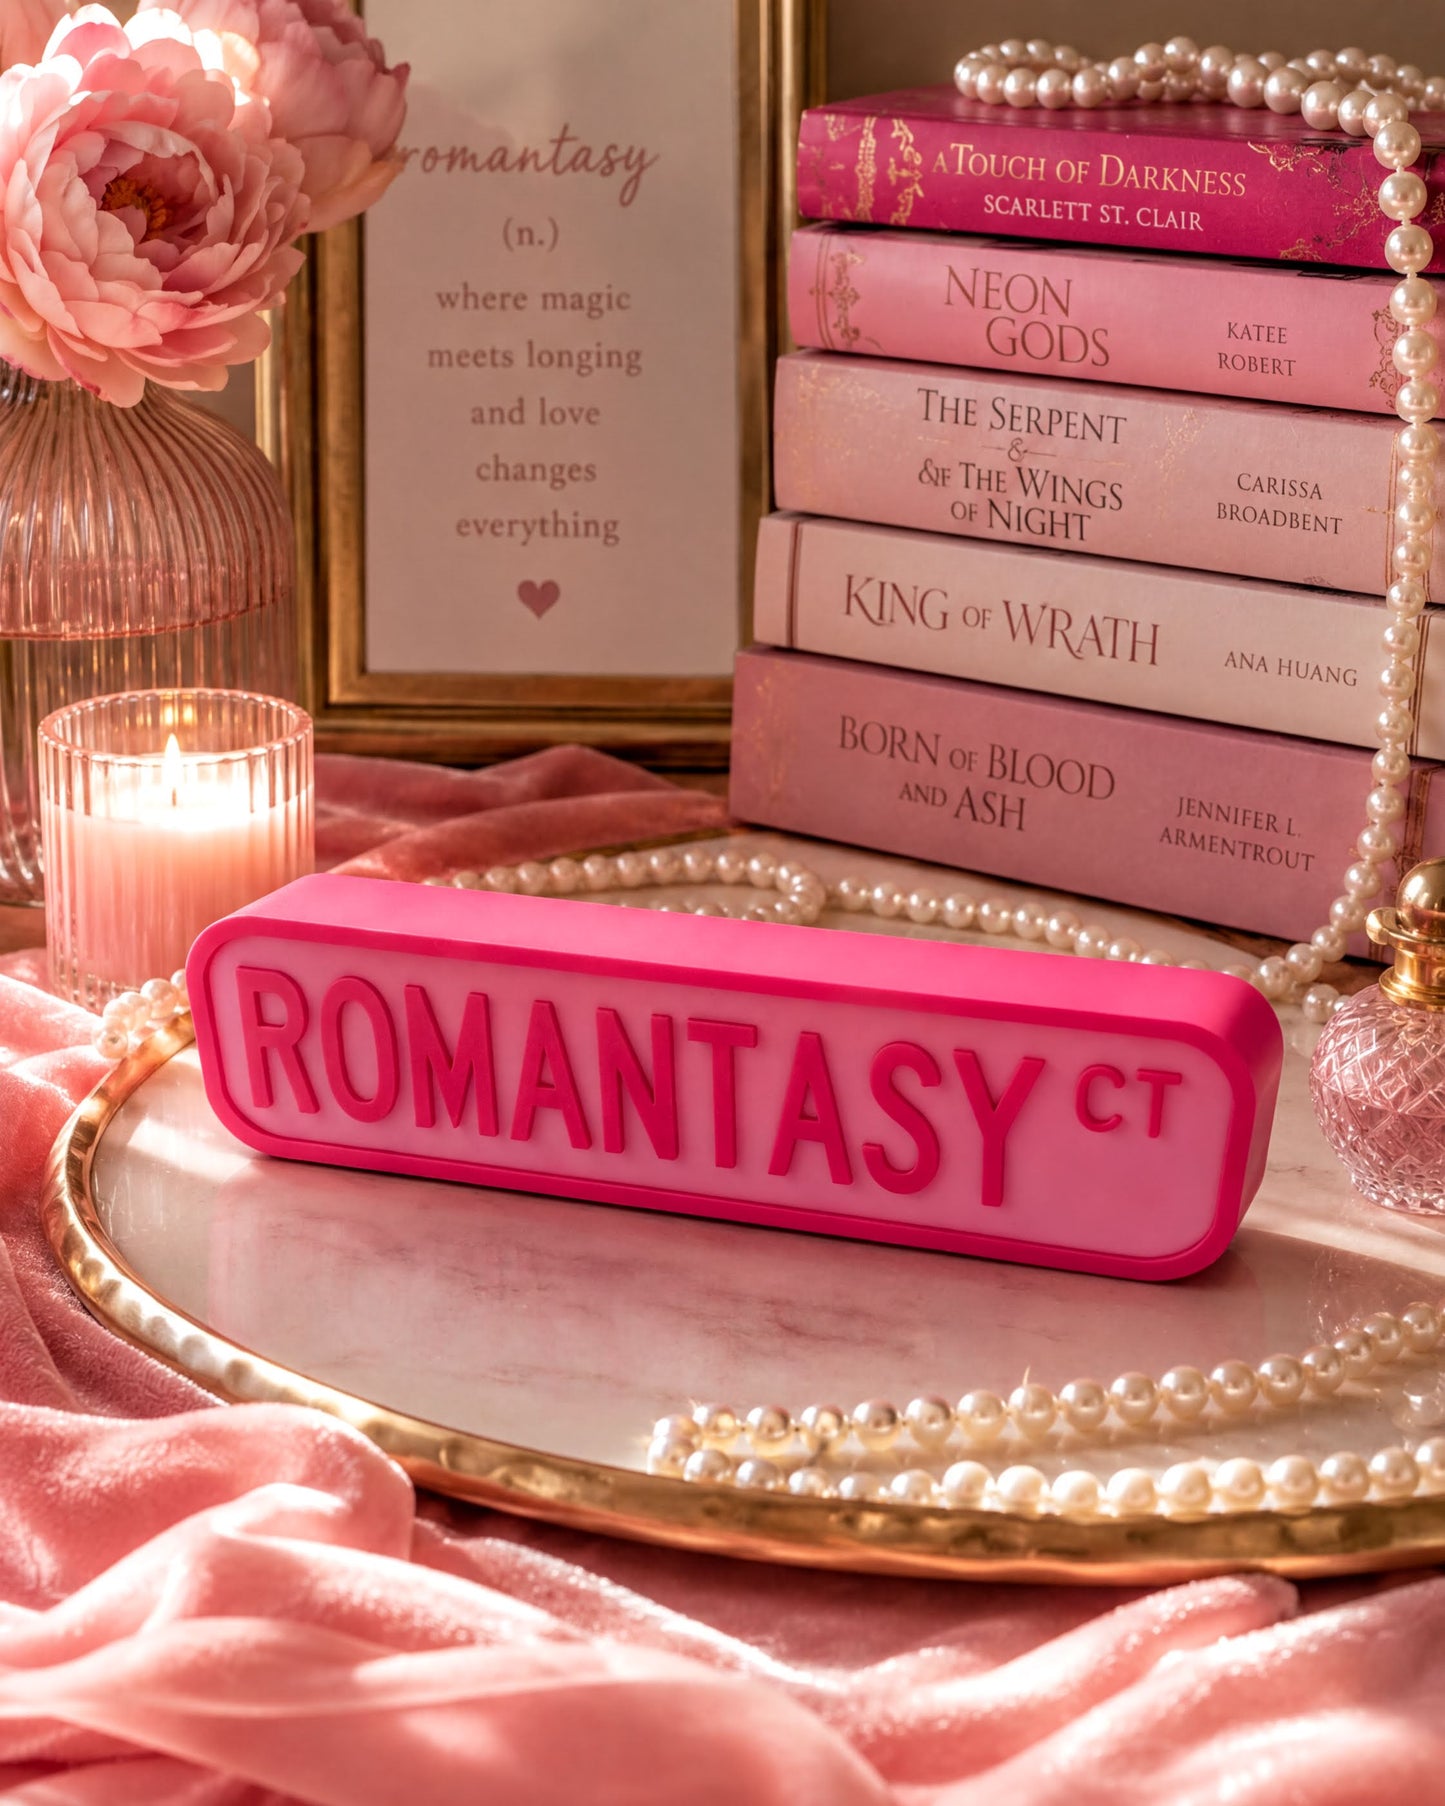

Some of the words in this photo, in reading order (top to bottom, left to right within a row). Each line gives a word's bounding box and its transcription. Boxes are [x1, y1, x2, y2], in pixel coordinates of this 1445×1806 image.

[399, 123, 659, 207] romantasy
[950, 143, 1046, 181] TOUCH
[1056, 159, 1090, 184] OF
[1099, 153, 1247, 197] DARKNESS
[984, 194, 1092, 222] SCARLETT
[1100, 205, 1130, 225] ST.
[1136, 208, 1204, 231] CLAIR
[502, 216, 559, 252] (n.)
[436, 282, 527, 310] where
[541, 284, 631, 319] magic
[944, 265, 1073, 318] NEON
[986, 316, 1111, 367] GODS
[1227, 321, 1288, 345] KATEE
[427, 344, 514, 369] meets
[527, 340, 642, 377] longing
[1217, 352, 1297, 377] ROBERT
[471, 397, 525, 426] and
[539, 397, 601, 426] love
[917, 388, 977, 427] THE
[989, 396, 1128, 444] SERPENT
[475, 454, 598, 490] changes
[959, 462, 1007, 494] THE
[1016, 466, 1123, 511] WINGS
[1237, 472, 1323, 500] CARISSA
[455, 511, 620, 546] everything
[951, 501, 978, 522] OF
[987, 498, 1092, 541] NIGHT
[1216, 502, 1343, 535] BROADBENT
[844, 573, 949, 630] KING
[962, 606, 992, 629] OF
[1002, 600, 1161, 667] WRATH
[1224, 651, 1269, 673] ANA
[1277, 658, 1358, 687] HUANG
[839, 715, 942, 767] BORN
[949, 748, 979, 772] OF
[987, 743, 1115, 801] BLOOD
[899, 782, 948, 808] AND
[953, 786, 1027, 832] ASH
[1177, 796, 1279, 833] JENNIFER
[1159, 826, 1316, 872] ARMENTROUT
[236, 963, 1046, 1208] ROMANTASY
[1074, 1063, 1184, 1141] CT
